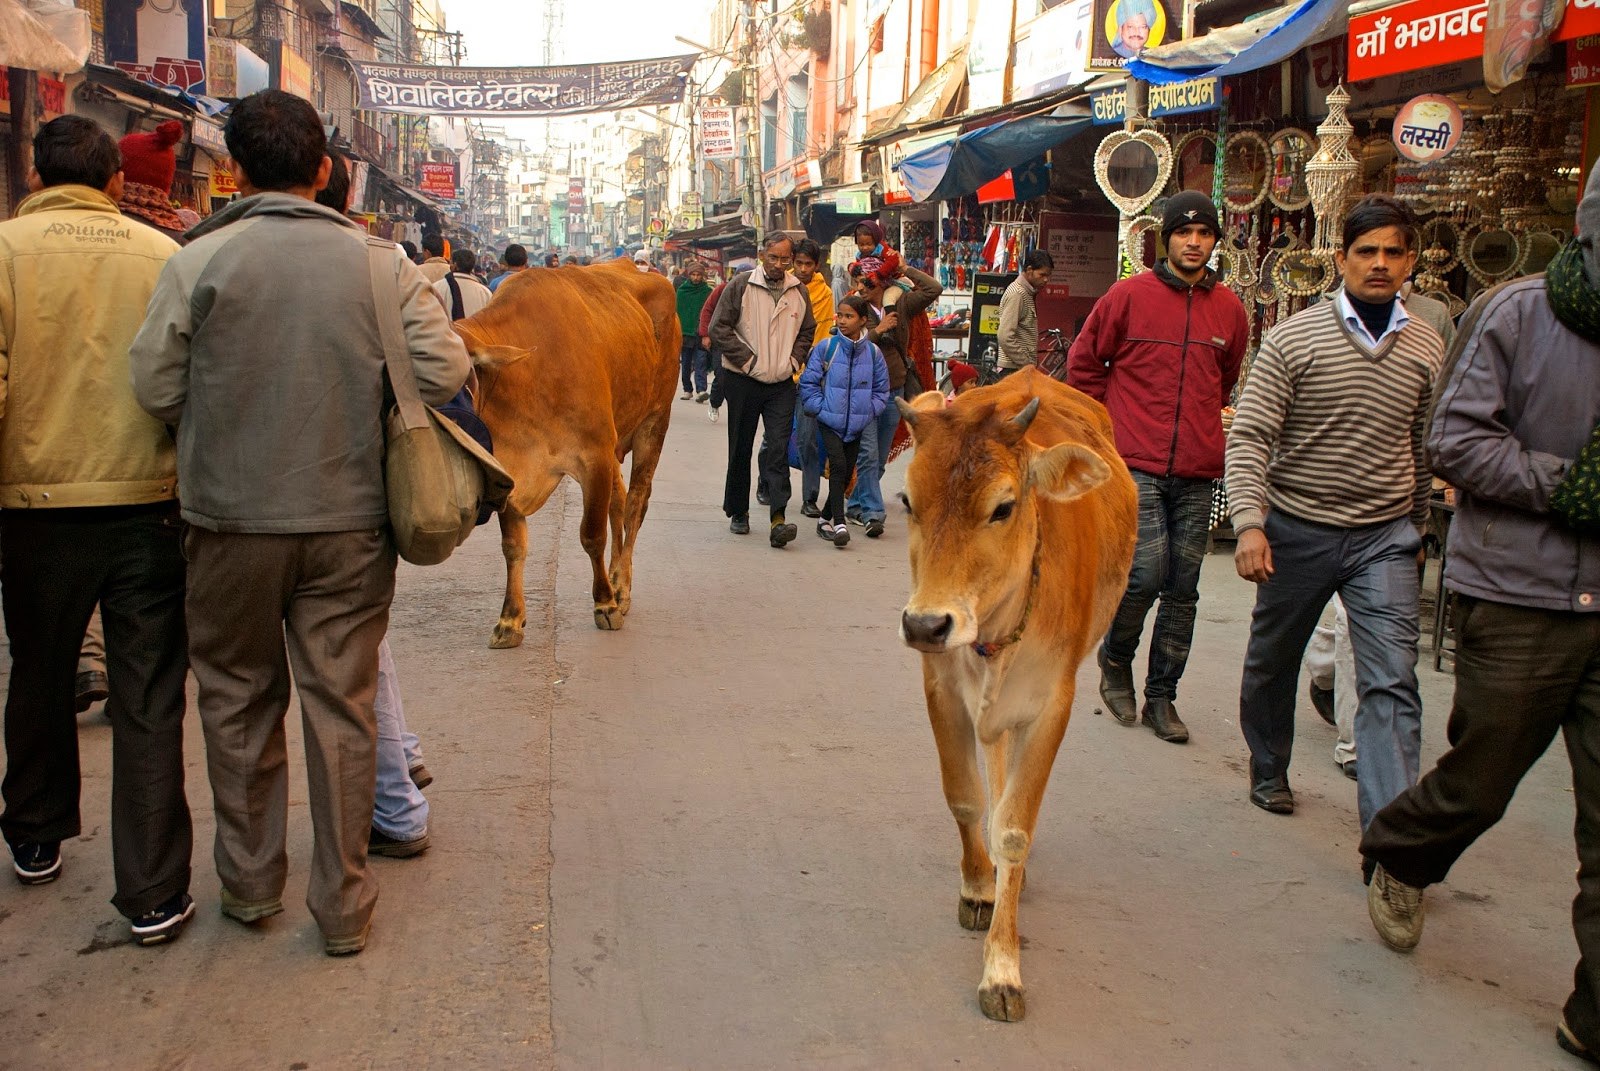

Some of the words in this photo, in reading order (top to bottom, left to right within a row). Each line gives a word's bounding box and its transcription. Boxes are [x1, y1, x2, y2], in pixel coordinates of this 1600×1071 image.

[1356, 16, 1392, 58] माँ
[367, 78, 484, 107] शिवालिक
[484, 80, 561, 109] ट्रेवल्स
[1399, 121, 1452, 151] लस्सी
[42, 222, 132, 240] Additional
[75, 236, 117, 244] SPORTS
[989, 286, 1004, 295] 3G
